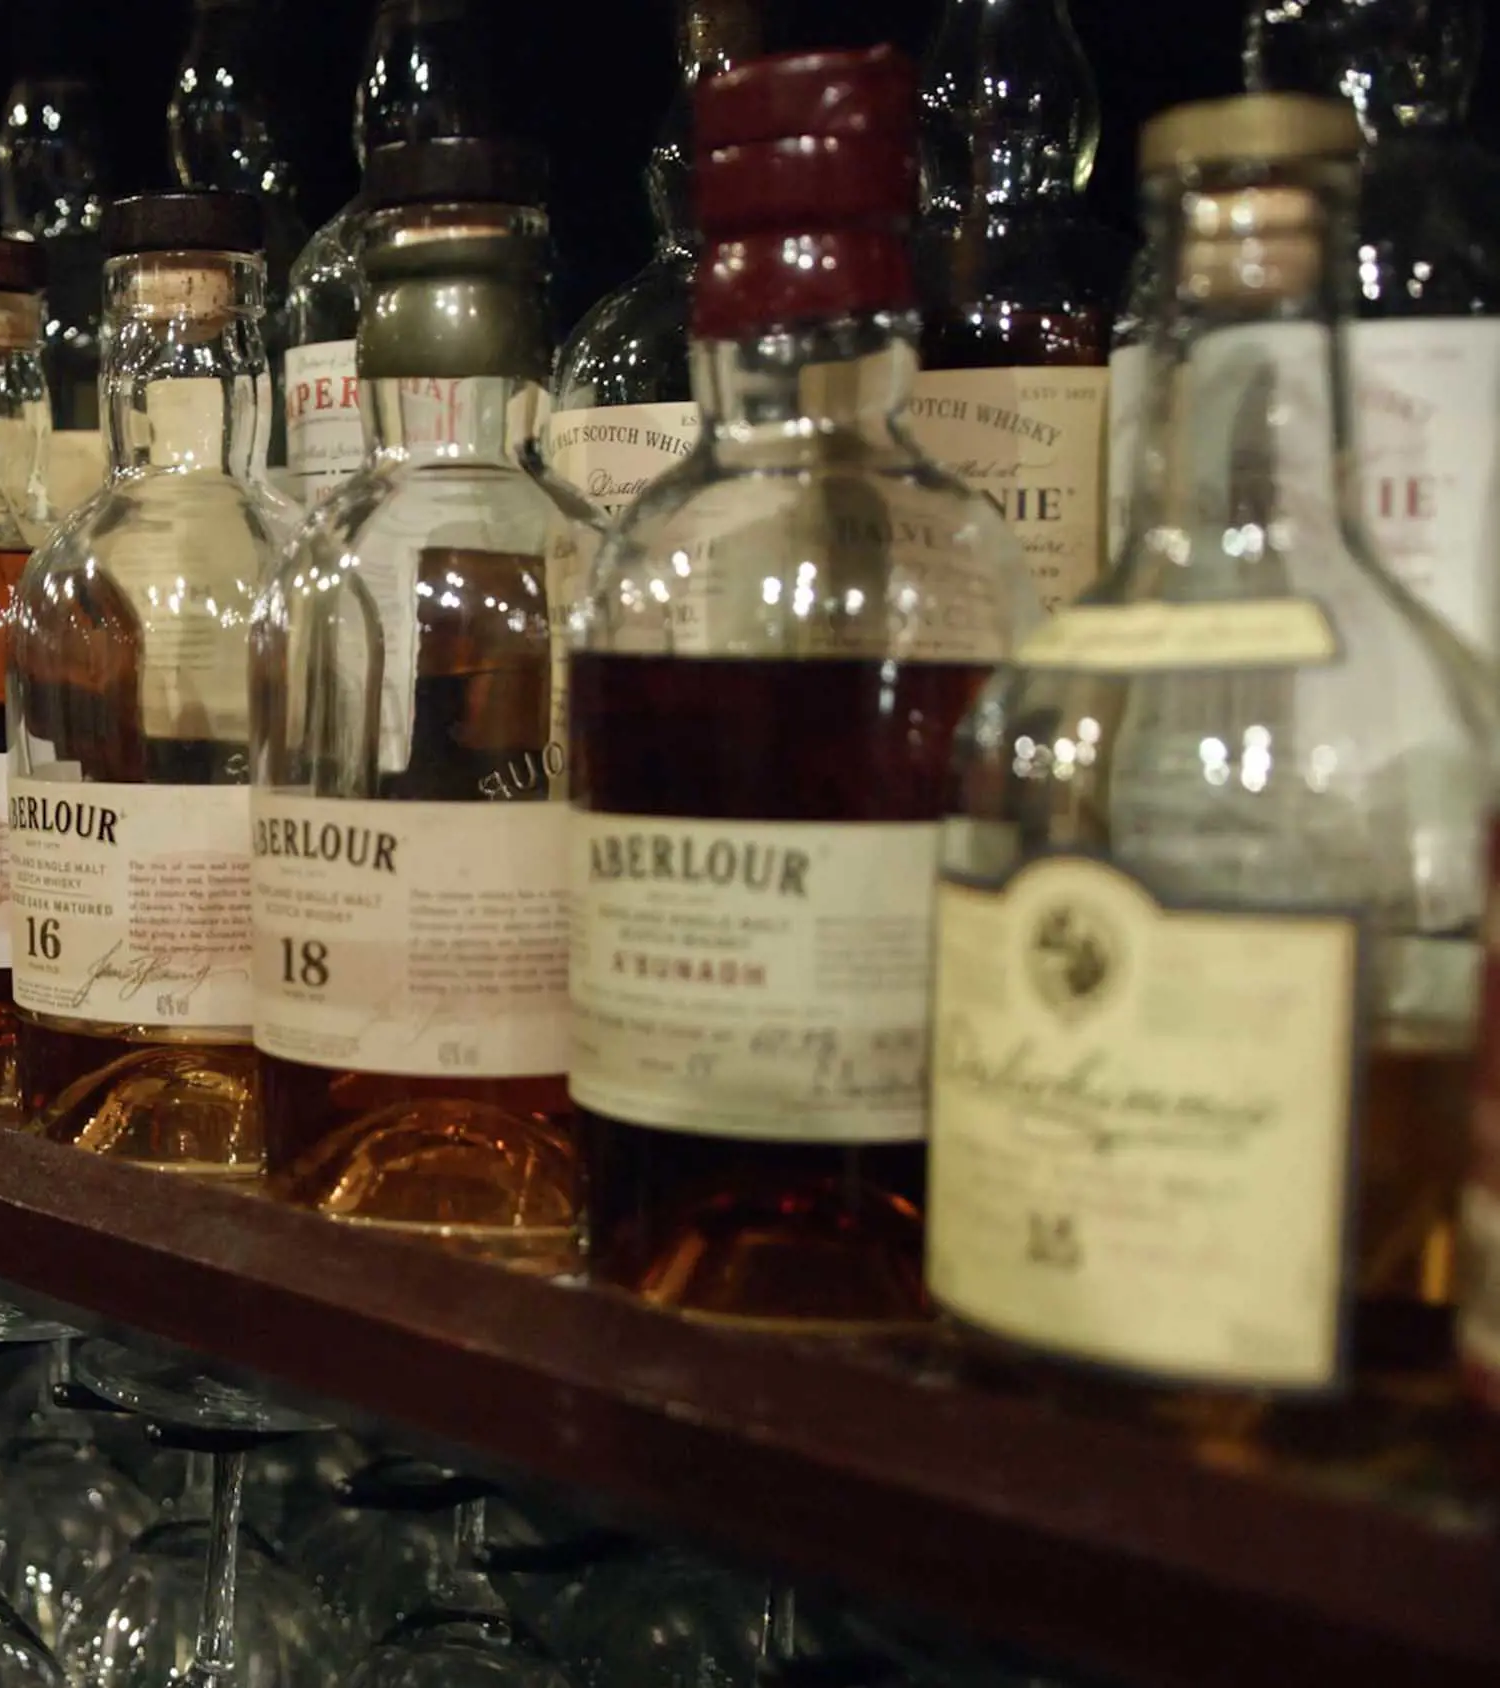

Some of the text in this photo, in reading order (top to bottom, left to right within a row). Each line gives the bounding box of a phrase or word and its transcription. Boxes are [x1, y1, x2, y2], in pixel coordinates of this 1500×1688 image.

[583, 424, 640, 446] SCOTCH
[975, 402, 1063, 447] WHISKY
[53, 900, 114, 916] MATURED
[27, 915, 62, 960] 16
[279, 933, 330, 987] 18
